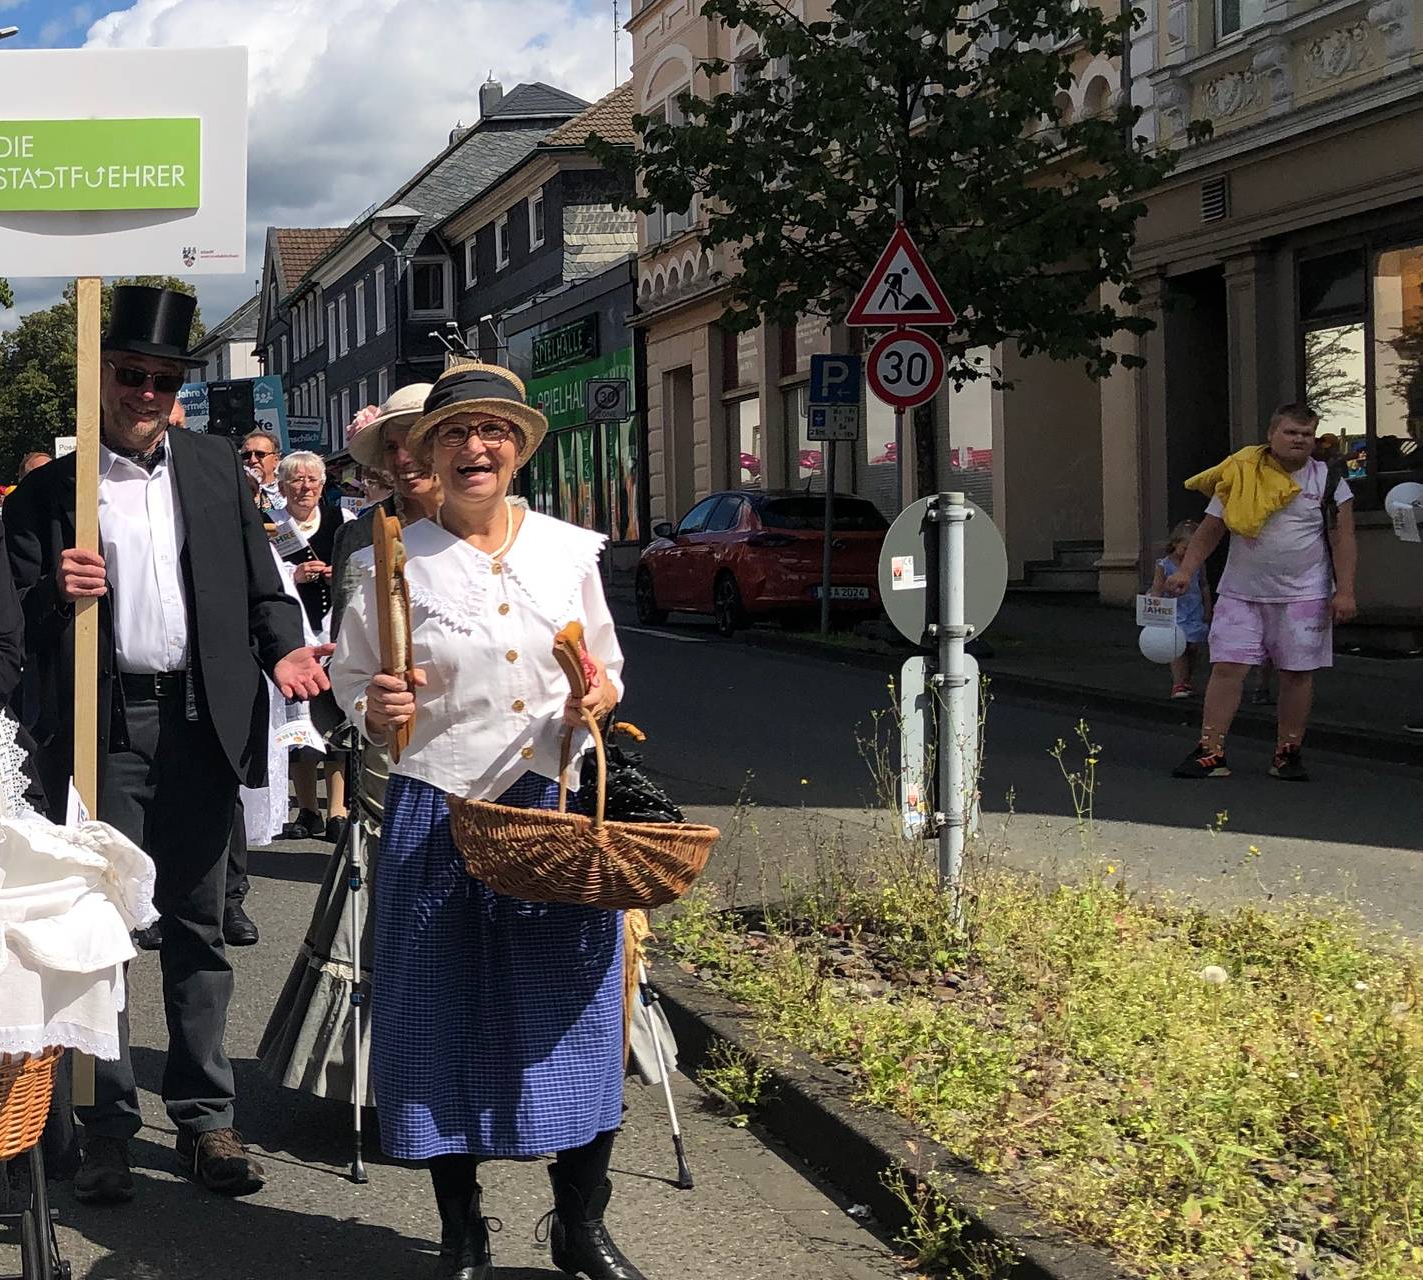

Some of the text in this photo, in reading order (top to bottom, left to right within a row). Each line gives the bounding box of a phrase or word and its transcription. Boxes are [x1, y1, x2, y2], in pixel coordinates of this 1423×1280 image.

[534, 328, 583, 365] SPIELHALLE
[822, 361, 849, 397] P
[882, 350, 927, 387] 30
[537, 378, 588, 416] SPIELHAL
[599, 391, 614, 403] 30
[1142, 606, 1174, 615] JAHRE
